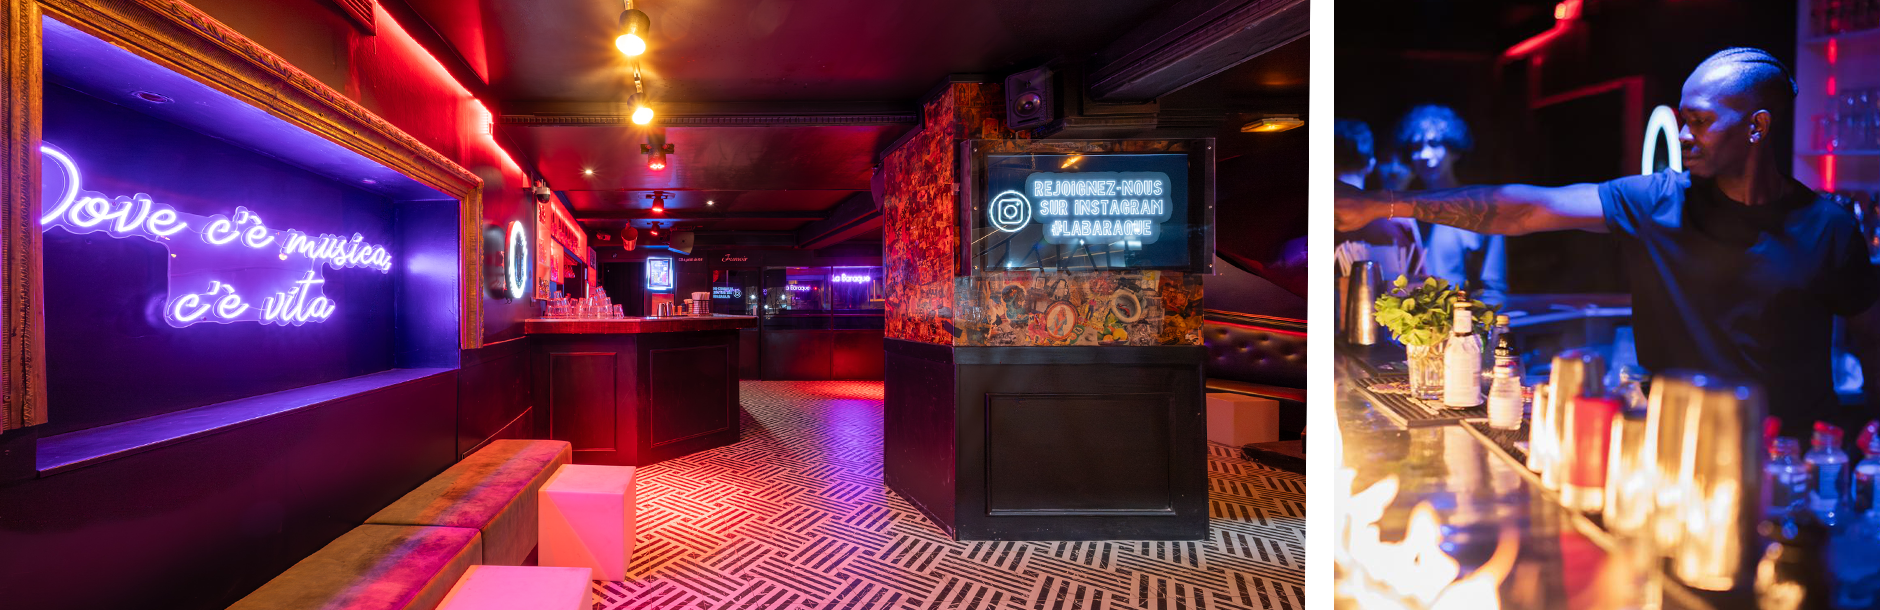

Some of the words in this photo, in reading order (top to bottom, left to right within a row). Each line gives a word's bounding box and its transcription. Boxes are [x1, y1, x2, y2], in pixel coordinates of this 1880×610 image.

[1034, 180, 1163, 197] REJOIGNEZ-NOUS
[1039, 199, 1069, 216] SUR
[1074, 199, 1164, 215] INSTAGRAM
[1051, 220, 1152, 236] #LABARAQUE
[206, 210, 276, 249] c'è
[285, 229, 393, 272] musica,
[841, 272, 871, 285] Baraque
[173, 280, 250, 317] c'è
[263, 269, 337, 322] vita
